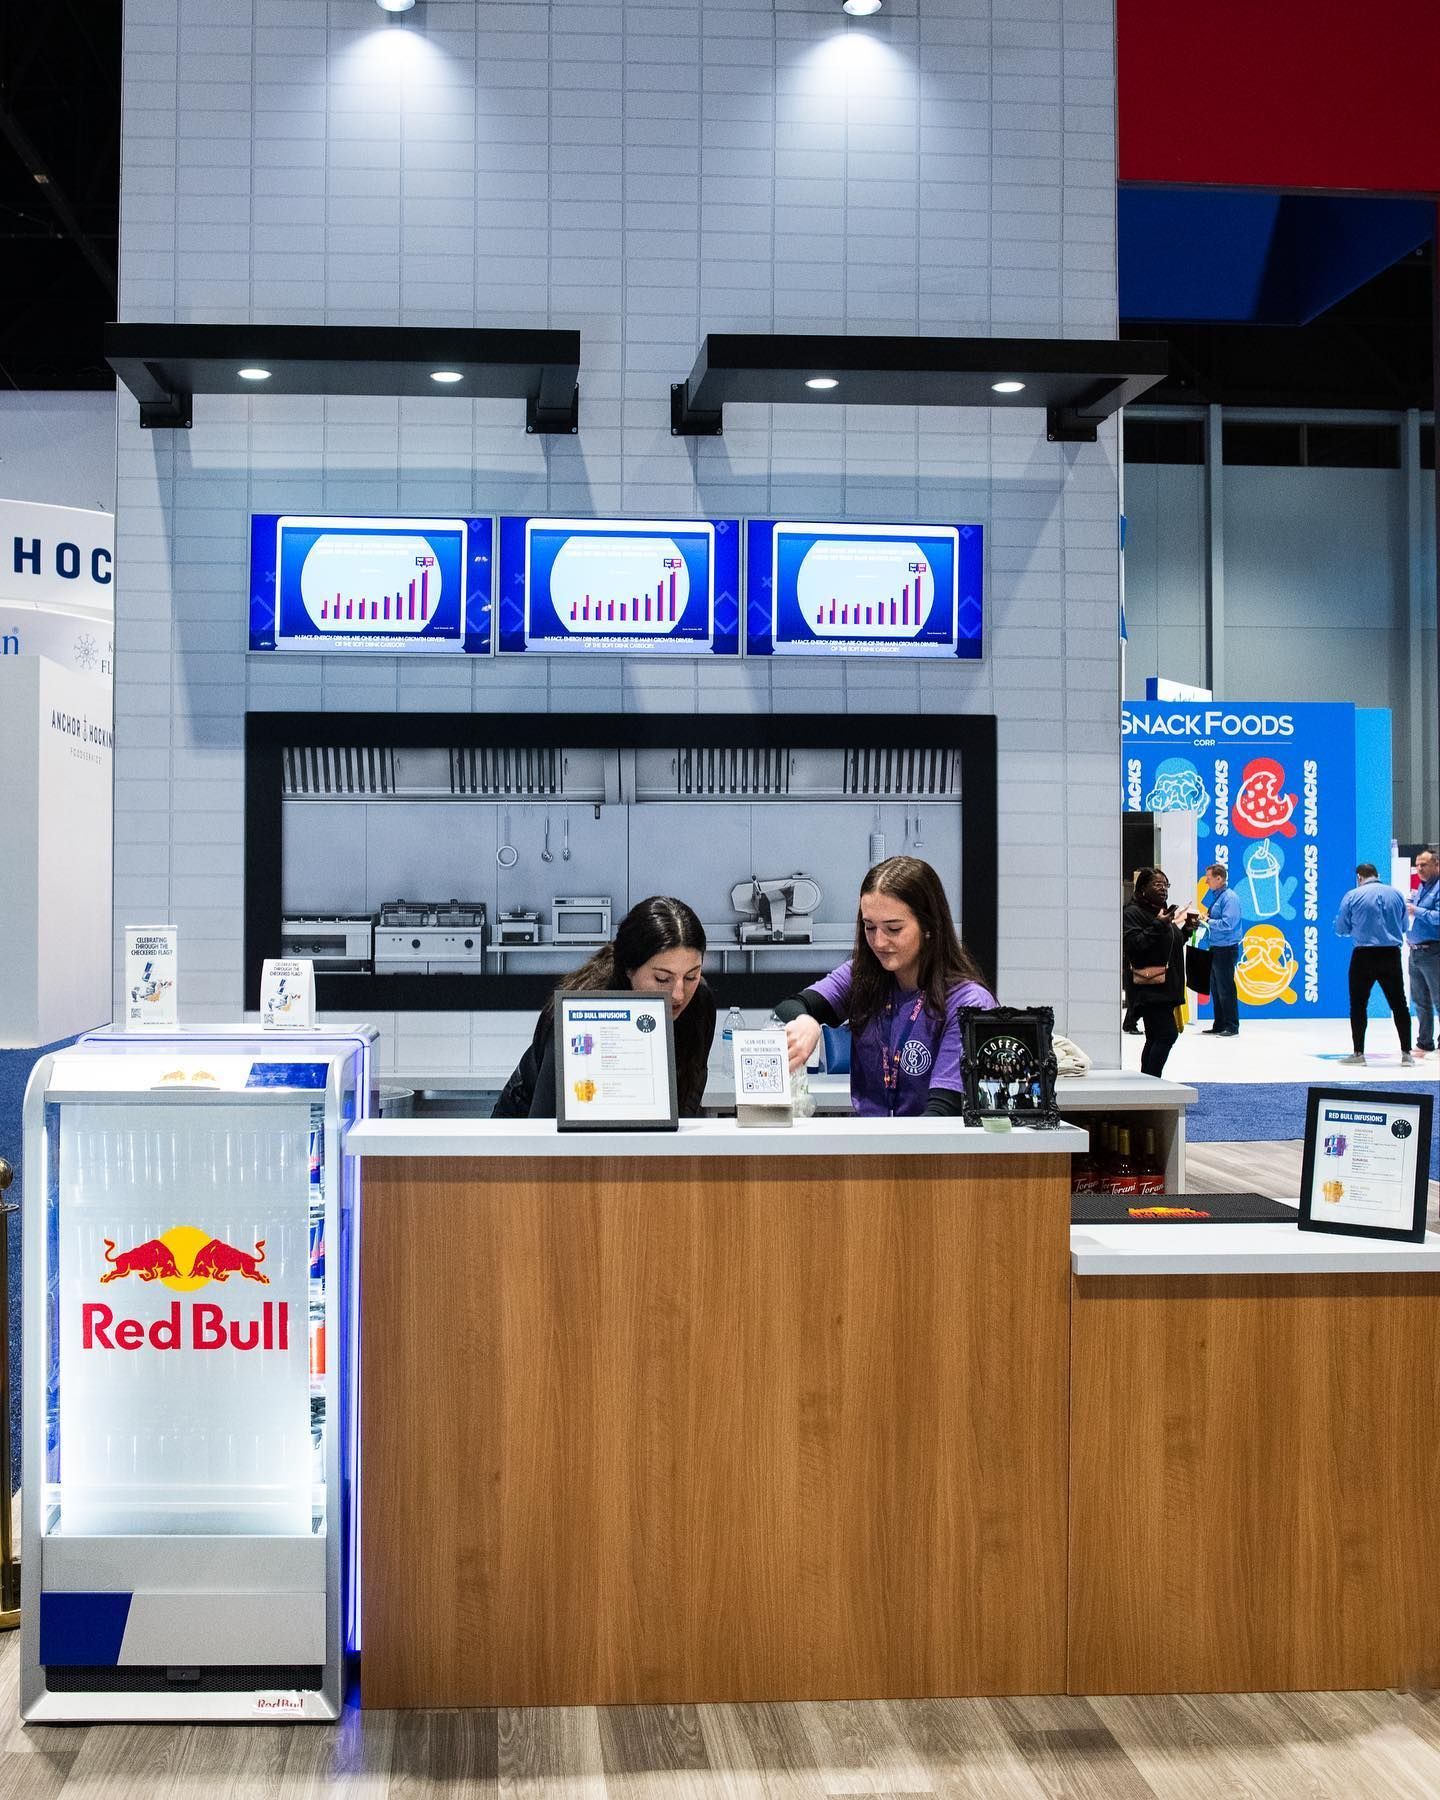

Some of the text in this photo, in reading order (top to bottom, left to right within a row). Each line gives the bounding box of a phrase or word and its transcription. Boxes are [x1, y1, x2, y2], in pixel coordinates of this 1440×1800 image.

[52, 709, 81, 737] ANCHOR
[1205, 711, 1294, 735] FOODS
[1215, 759, 1229, 837] SNACKS
[1304, 760, 1318, 837] SNACKS
[1304, 845, 1318, 920] SNACKS
[1304, 926, 1318, 1003] SNACKS
[983, 1039, 1025, 1056] COFFEE
[1353, 1114, 1383, 1122] INFUSIONS
[1110, 1182, 1137, 1195] Torani
[82, 1301, 288, 1350] Red Bull
